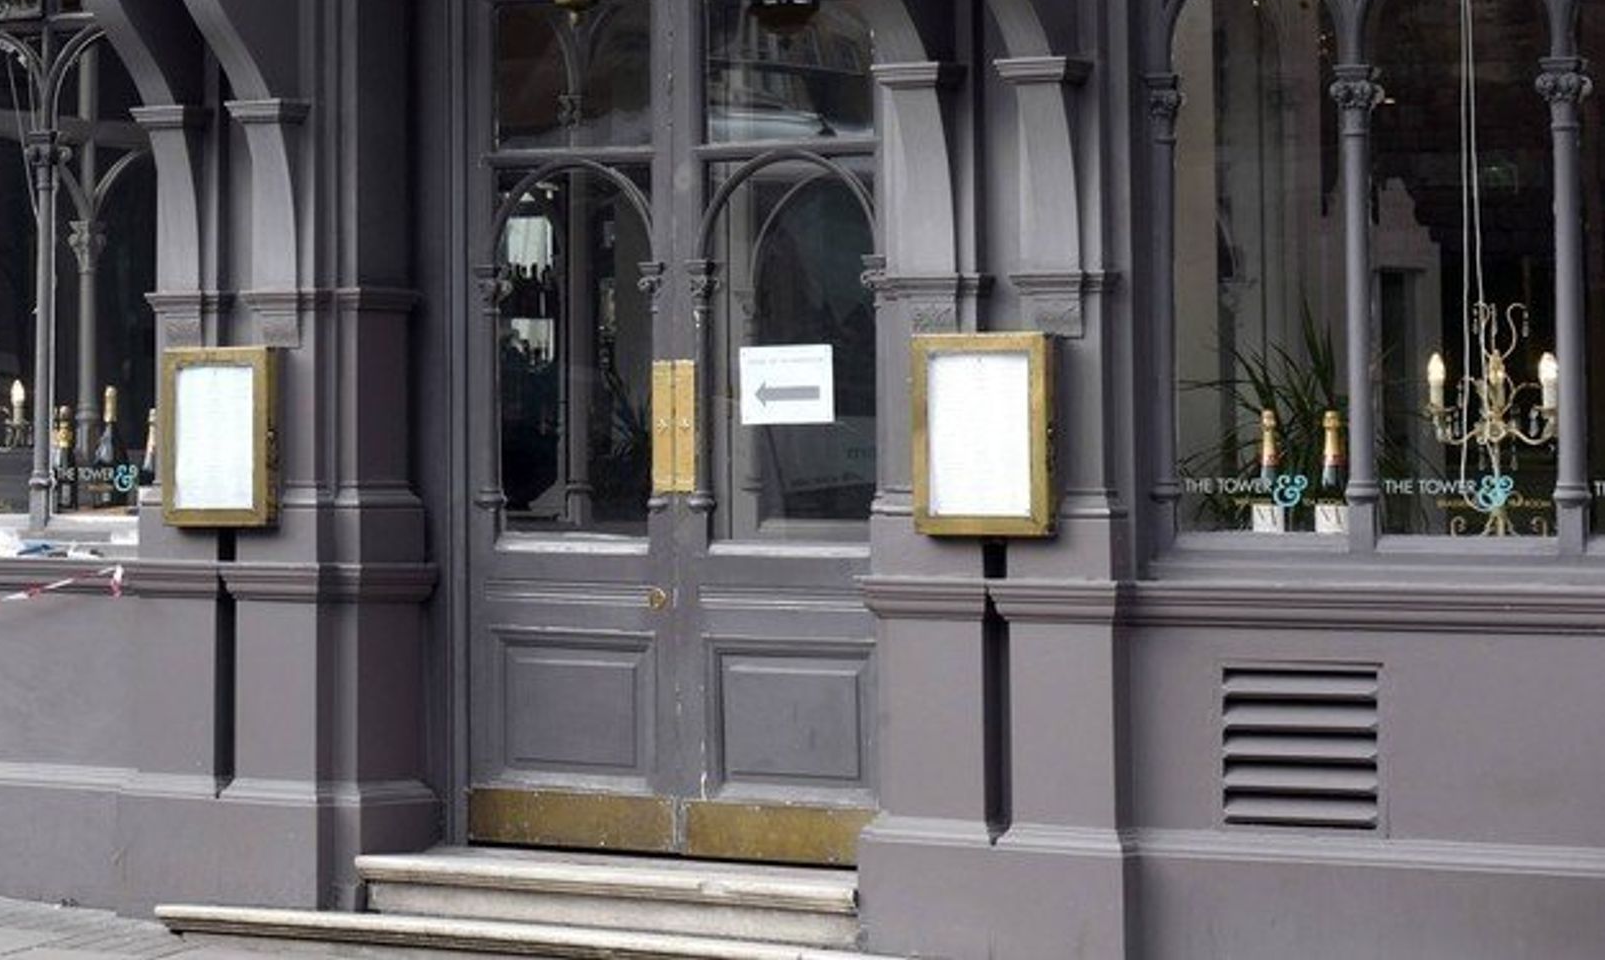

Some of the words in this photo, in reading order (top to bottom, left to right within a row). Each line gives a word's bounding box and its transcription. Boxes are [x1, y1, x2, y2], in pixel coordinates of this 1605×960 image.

[57, 466, 76, 481] THE
[78, 466, 114, 481] TOWER
[1184, 477, 1212, 495] THE
[1216, 476, 1273, 494] TOWER
[1384, 479, 1414, 495] THE
[1418, 479, 1477, 495] TOWER
